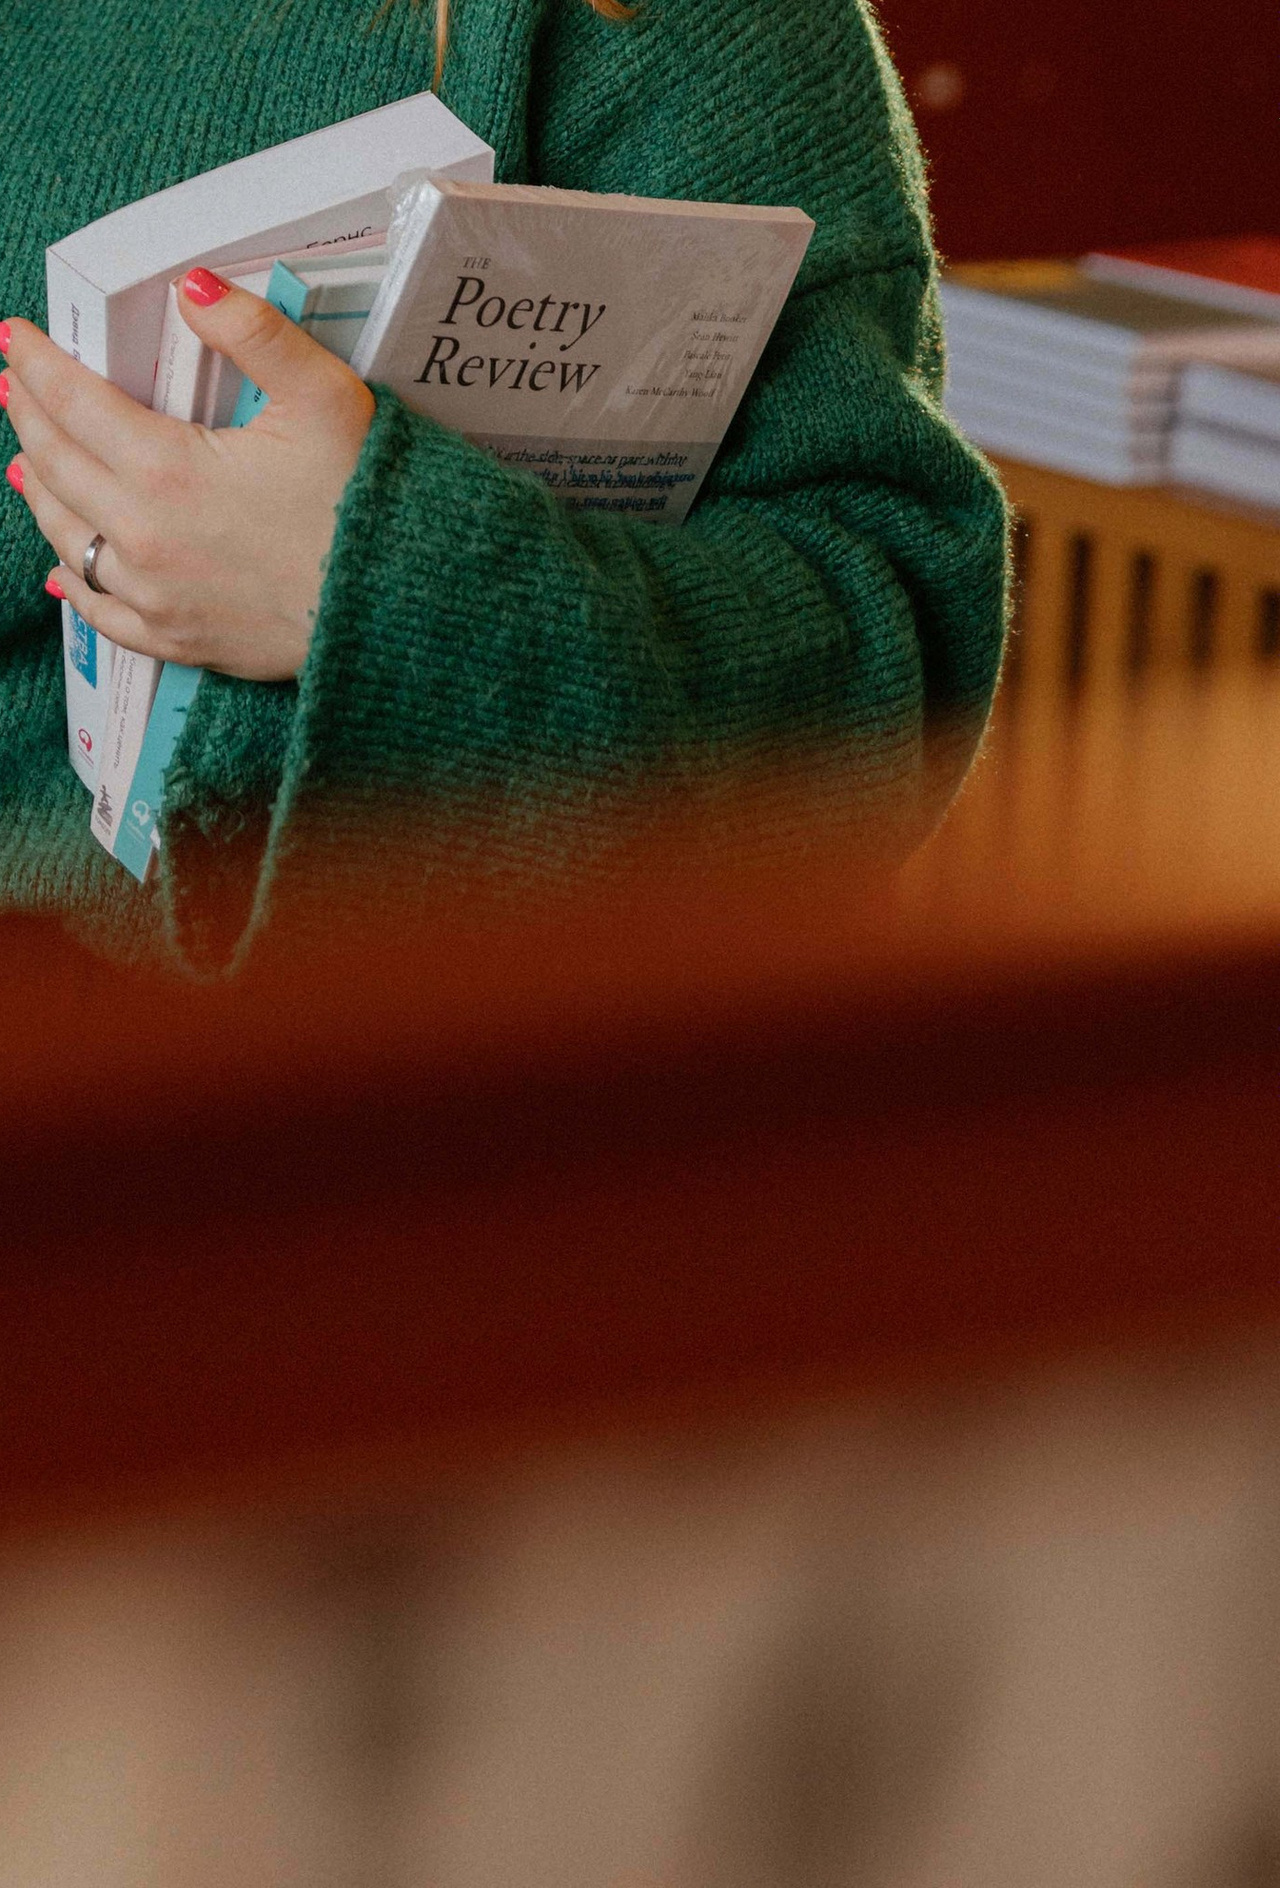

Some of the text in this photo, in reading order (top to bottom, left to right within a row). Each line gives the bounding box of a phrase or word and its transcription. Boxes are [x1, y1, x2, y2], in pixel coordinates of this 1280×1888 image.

[463, 256, 491, 270] THE
[438, 276, 606, 352] Poetry
[413, 335, 602, 394] Review
